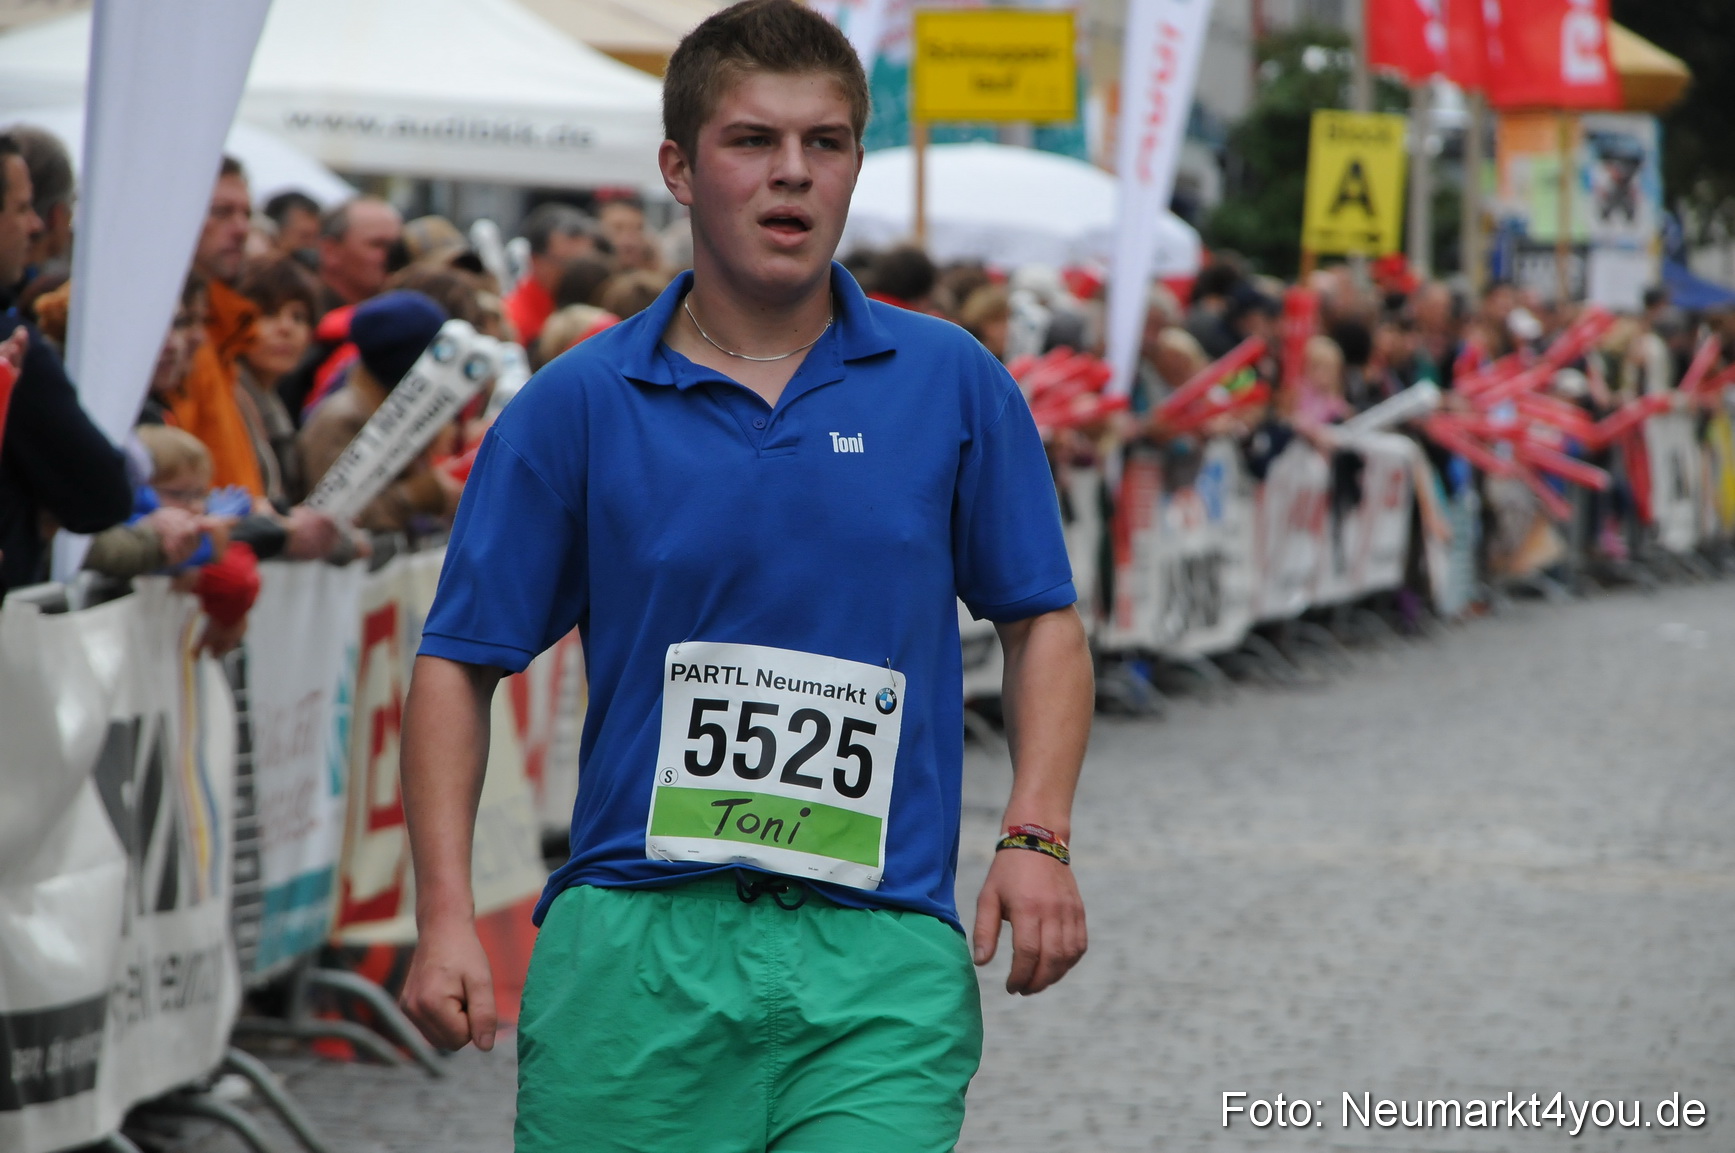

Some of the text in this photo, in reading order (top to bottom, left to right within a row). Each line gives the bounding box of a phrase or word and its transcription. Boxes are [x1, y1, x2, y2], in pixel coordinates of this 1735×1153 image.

[1329, 158, 1376, 217] A
[829, 431, 864, 453] Toni
[670, 663, 867, 706] PARTL Neumarkt
[683, 697, 878, 799] 5525
[710, 798, 812, 845] Toni
